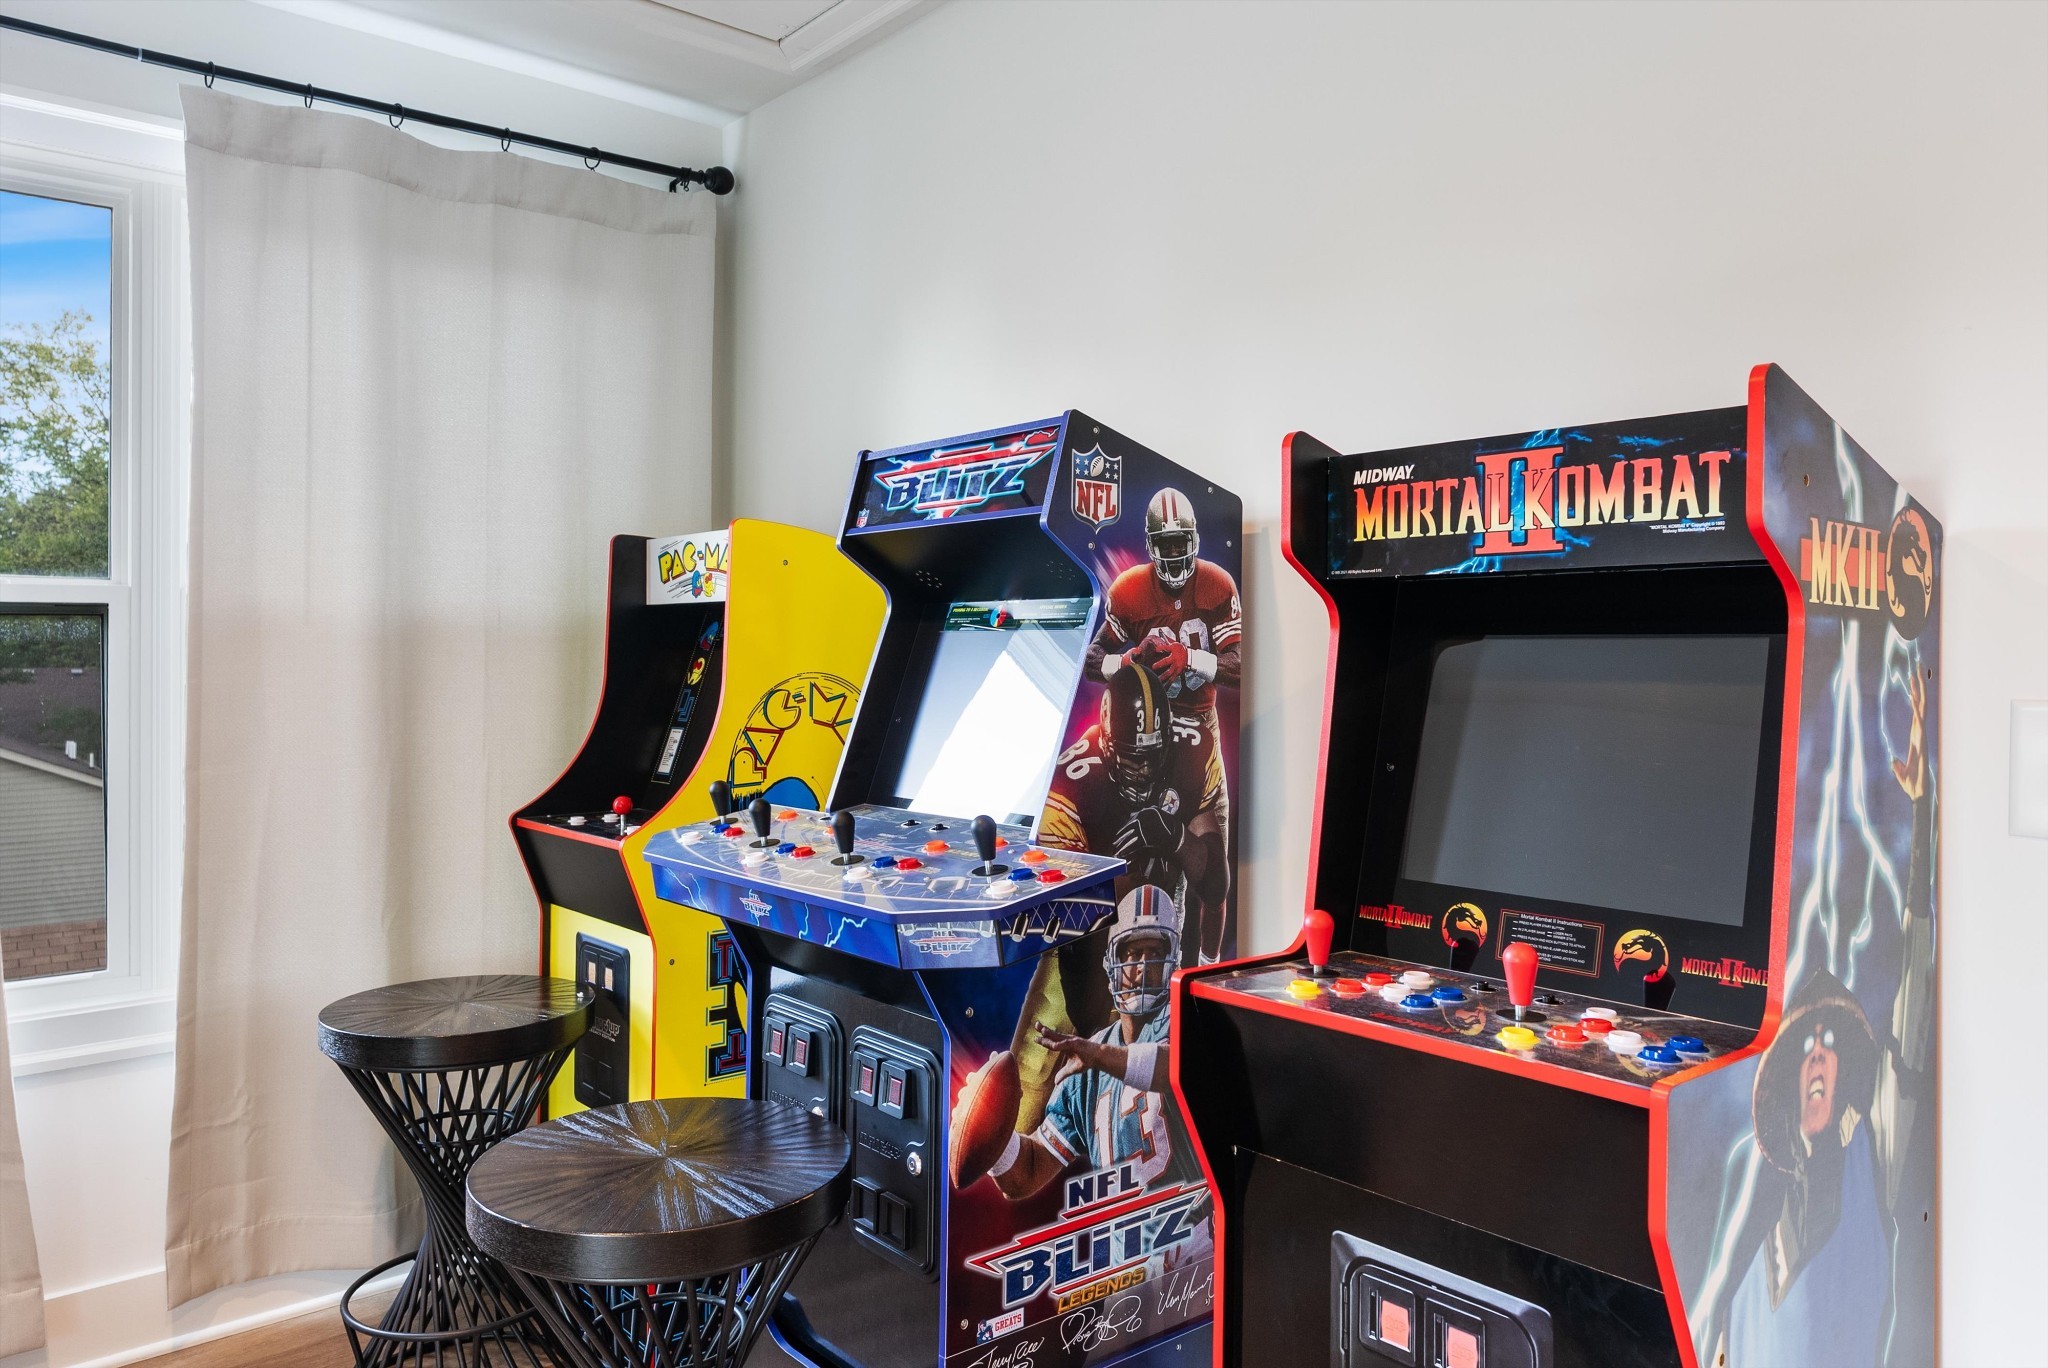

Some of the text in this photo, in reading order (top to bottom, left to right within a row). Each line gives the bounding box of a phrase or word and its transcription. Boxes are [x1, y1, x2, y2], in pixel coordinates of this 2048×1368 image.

[887, 457, 1033, 510] BLITZ
[1353, 464, 1415, 485] MIDWAY
[1076, 480, 1117, 523] NFL
[1353, 450, 1731, 542] MORTAL KOMBAT
[1808, 517, 1881, 610] MKII
[1136, 708, 1161, 732] 36
[932, 929, 956, 938] NFL
[1359, 904, 1433, 930] MORTAL KOMBAT
[1520, 913, 1535, 921] Mortal
[1535, 915, 1553, 923] Kombat
[1557, 919, 1583, 928] Instructions
[919, 942, 973, 952] BLITZ
[1680, 957, 1731, 981] MORTAL
[1094, 1083, 1172, 1184] 13
[1068, 1164, 1141, 1210] NFL
[999, 1194, 1201, 1307] BLITZ
[1058, 1267, 1146, 1313] LEGENDS
[994, 1313, 1023, 1332] GREATS
